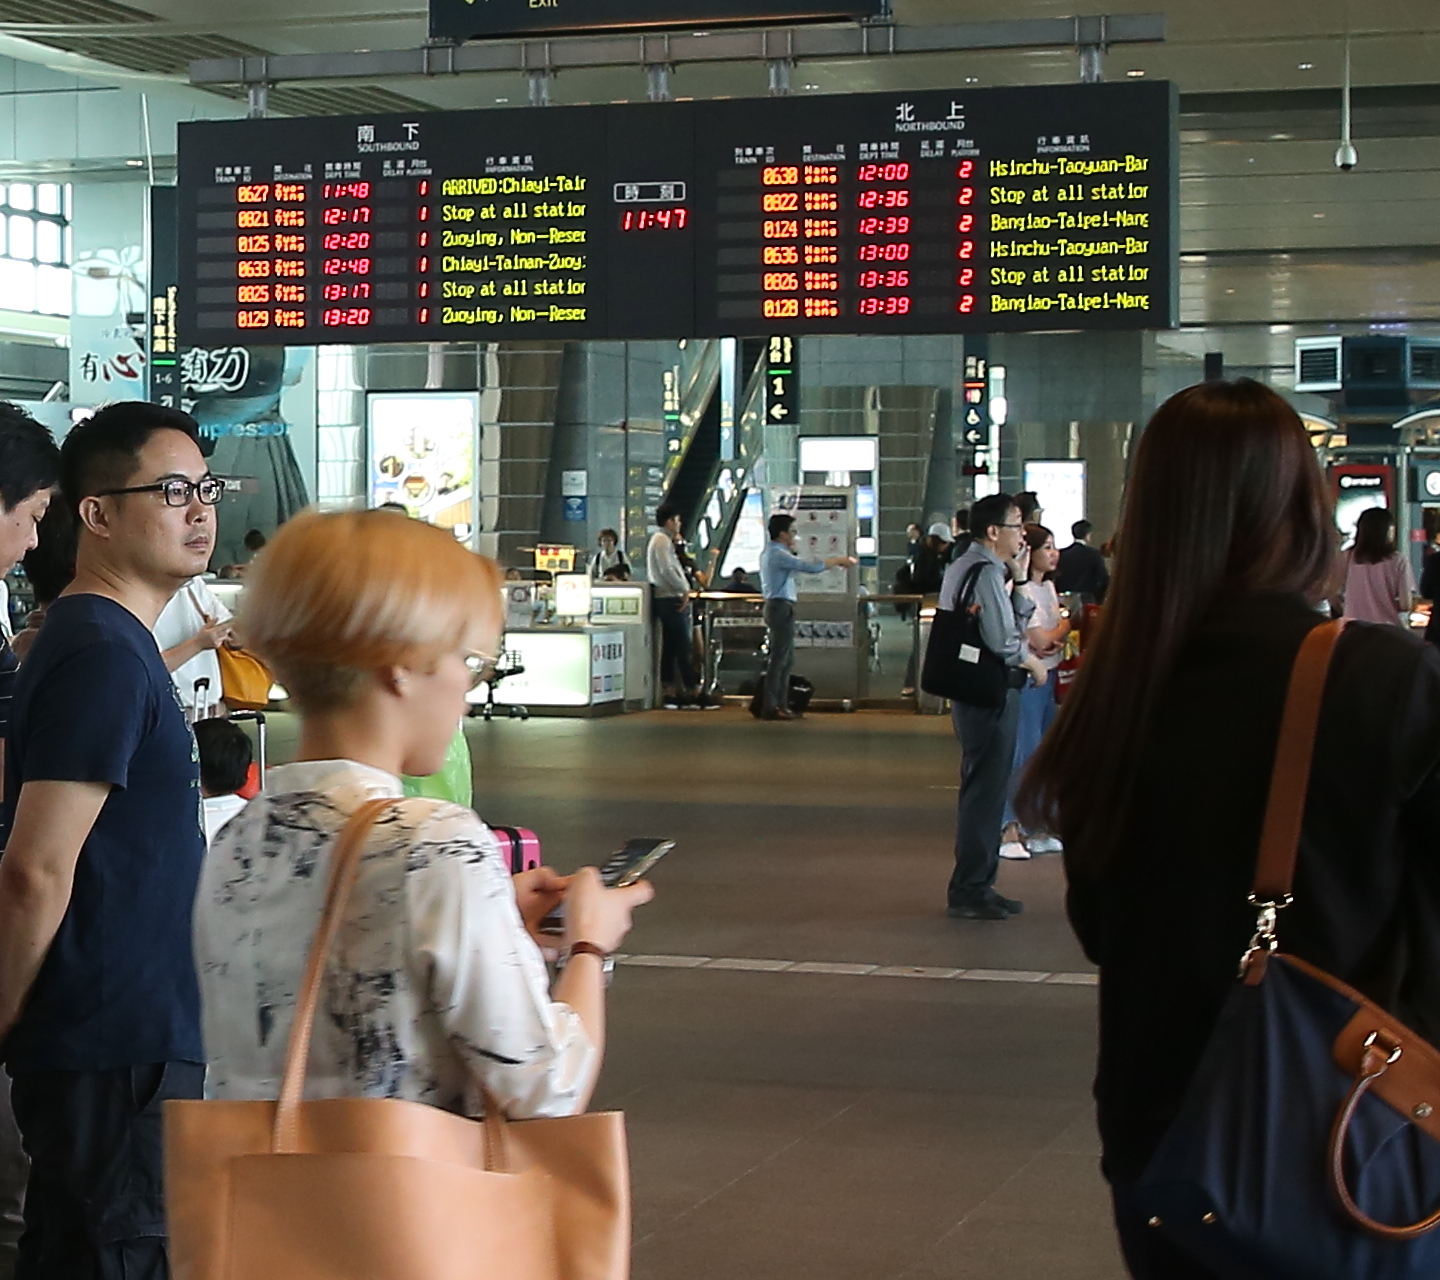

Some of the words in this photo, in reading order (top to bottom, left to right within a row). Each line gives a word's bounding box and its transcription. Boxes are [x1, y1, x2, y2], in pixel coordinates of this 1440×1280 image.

[895, 120, 966, 132] NORTHBOUND
[357, 141, 420, 153] SOUTHBOUND
[857, 163, 910, 181] 12:00
[958, 161, 973, 179] 2
[323, 182, 371, 199] 11:48
[857, 190, 910, 208] 12:36
[958, 188, 973, 206] 2
[990, 186, 1026, 205] Stop
[1032, 186, 1049, 202] at
[1057, 184, 1084, 201] all
[323, 207, 371, 224] 12:17
[442, 206, 475, 225] Stop
[480, 206, 496, 221] at
[503, 204, 527, 220] all
[621, 208, 688, 231] 11:47
[857, 217, 910, 235] 12:39
[958, 215, 973, 232] 2
[323, 232, 371, 250] 12:20
[857, 244, 910, 261] 13:00
[958, 241, 973, 259] 2
[323, 258, 371, 275] 12:48
[857, 270, 910, 288] 13:36
[958, 268, 973, 286] 2
[990, 267, 1026, 286] Stop
[1032, 267, 1050, 283] at
[1057, 266, 1084, 282] all
[323, 283, 371, 300] 13:17
[442, 282, 475, 301] Stop
[480, 282, 496, 297] at
[503, 280, 527, 296] all
[857, 297, 910, 314] 13:39
[958, 295, 973, 313] 2
[323, 308, 371, 325] 13:20
[772, 376, 785, 397] 1
